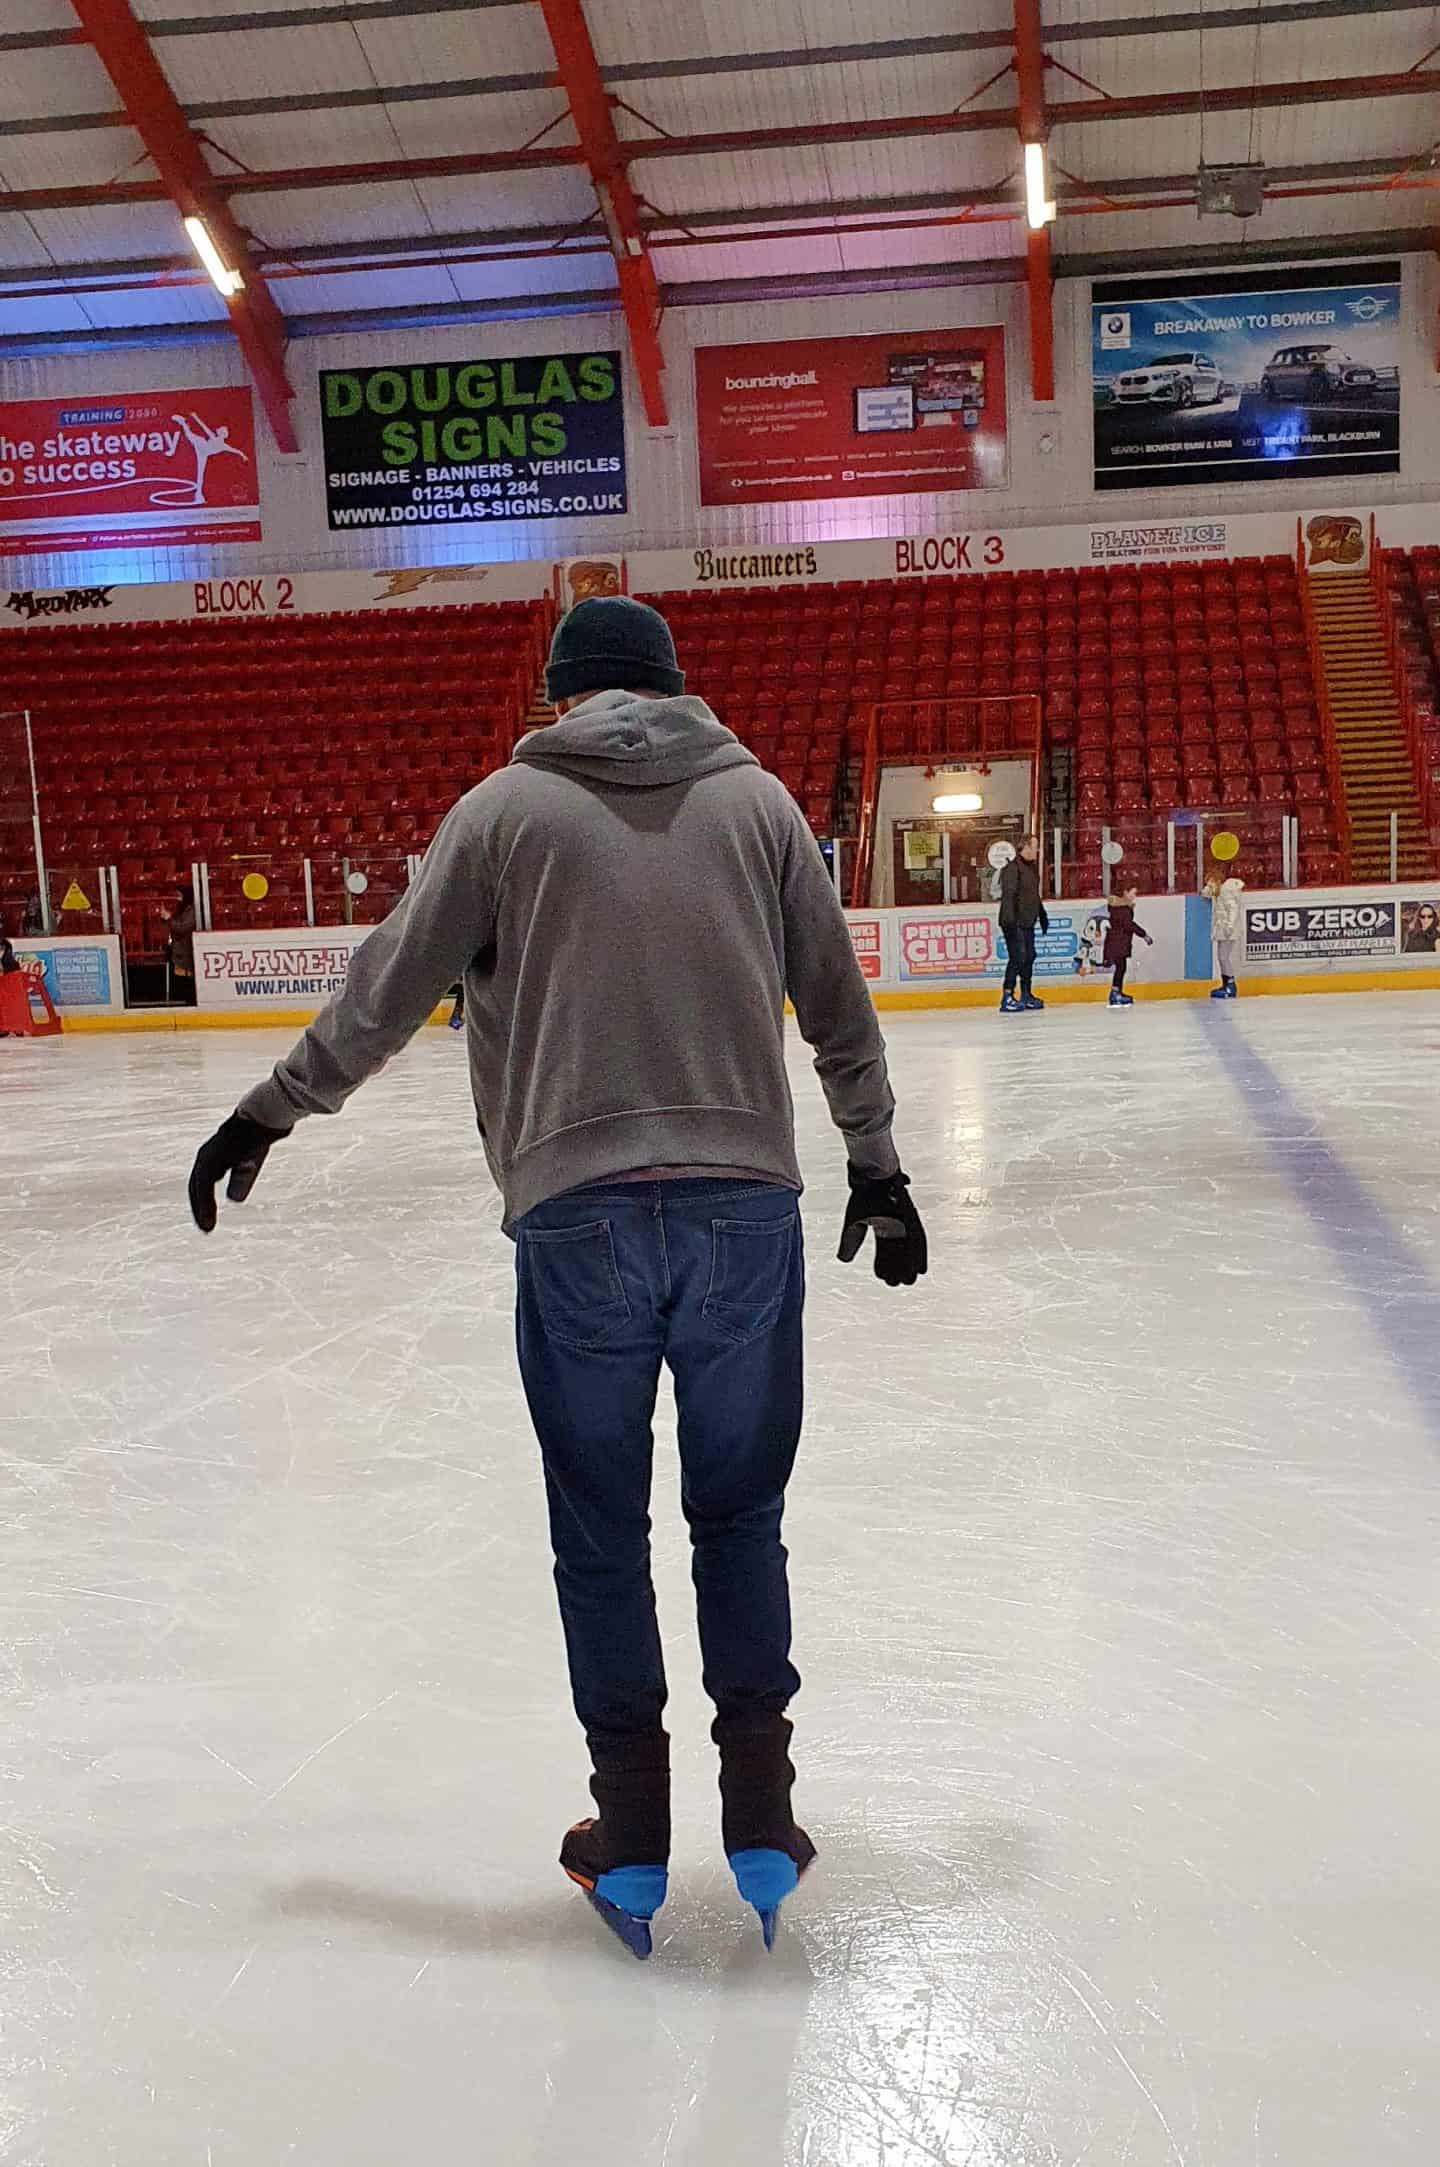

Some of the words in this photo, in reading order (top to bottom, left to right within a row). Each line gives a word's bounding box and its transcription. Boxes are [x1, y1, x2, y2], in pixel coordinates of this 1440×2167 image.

[1154, 313, 1243, 336] BREAKAWAY
[1249, 312, 1269, 329] TO
[1271, 310, 1336, 328] BOWKER
[325, 356, 614, 417] DOUGLAS
[63, 409, 122, 424] TRAINING
[0, 436, 35, 461] he
[43, 430, 181, 457] skateway
[381, 412, 567, 465] SIGNS
[23, 459, 136, 485] success
[329, 470, 410, 487] SIGNAGE
[426, 464, 513, 483] BANNERS
[529, 457, 621, 476] VEHICLES
[412, 485, 464, 501] 01254
[470, 483, 502, 497] 694
[507, 480, 539, 495] 284
[333, 494, 622, 525] WWW.DOUGLAS-SIGNS.CO.UK
[1091, 526, 1182, 549] PLANET
[1183, 524, 1226, 543] ICE
[896, 537, 971, 572] BLOCK
[983, 536, 1005, 565] 3
[194, 579, 265, 613] BLOCK
[277, 578, 294, 610] 2
[906, 922, 986, 940] PENGUIN
[1250, 911, 1301, 932] SUB
[1307, 907, 1377, 929] ZERO
[1307, 929, 1341, 939] PARTY
[1343, 927, 1375, 937] NIGHT
[907, 937, 986, 962] CLUB
[203, 947, 349, 979] PLANET
[235, 978, 346, 995] WWW.PLANET-IC
